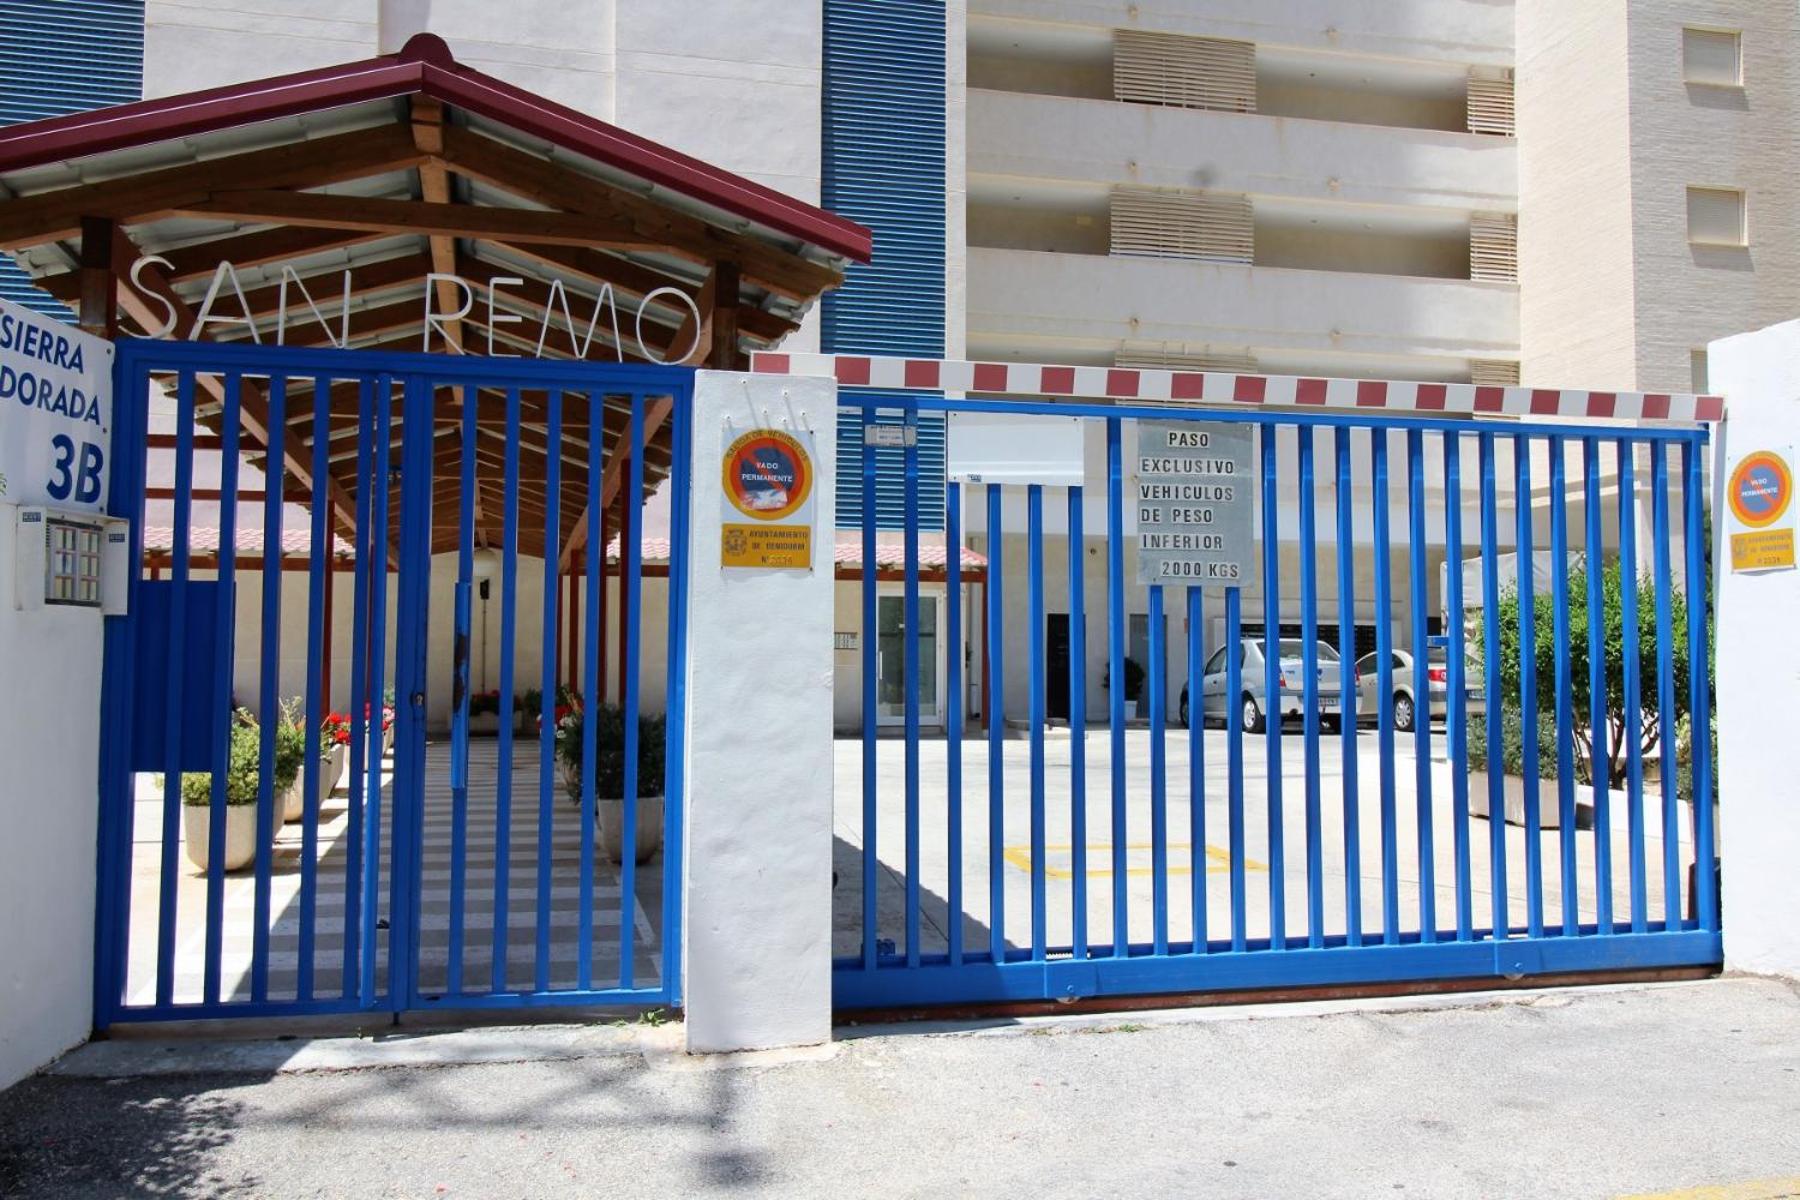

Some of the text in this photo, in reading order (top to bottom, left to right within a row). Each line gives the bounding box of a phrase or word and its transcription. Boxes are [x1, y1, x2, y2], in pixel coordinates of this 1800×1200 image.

[117, 254, 702, 366] SAN REMO
[0, 314, 84, 375] SIERRA
[0, 364, 101, 426] DORADA
[1168, 432, 1209, 447] PASO
[46, 433, 104, 504] 3B
[756, 461, 779, 470] VADO
[1141, 458, 1234, 474] EXCLUSIVO
[741, 473, 793, 482] PERMANENTE
[1140, 485, 1233, 501] VEHICULOS
[1141, 508, 1213, 523] DE PESO
[1142, 534, 1223, 549] INFERIOR
[1162, 562, 1239, 578] 2000 KGS
